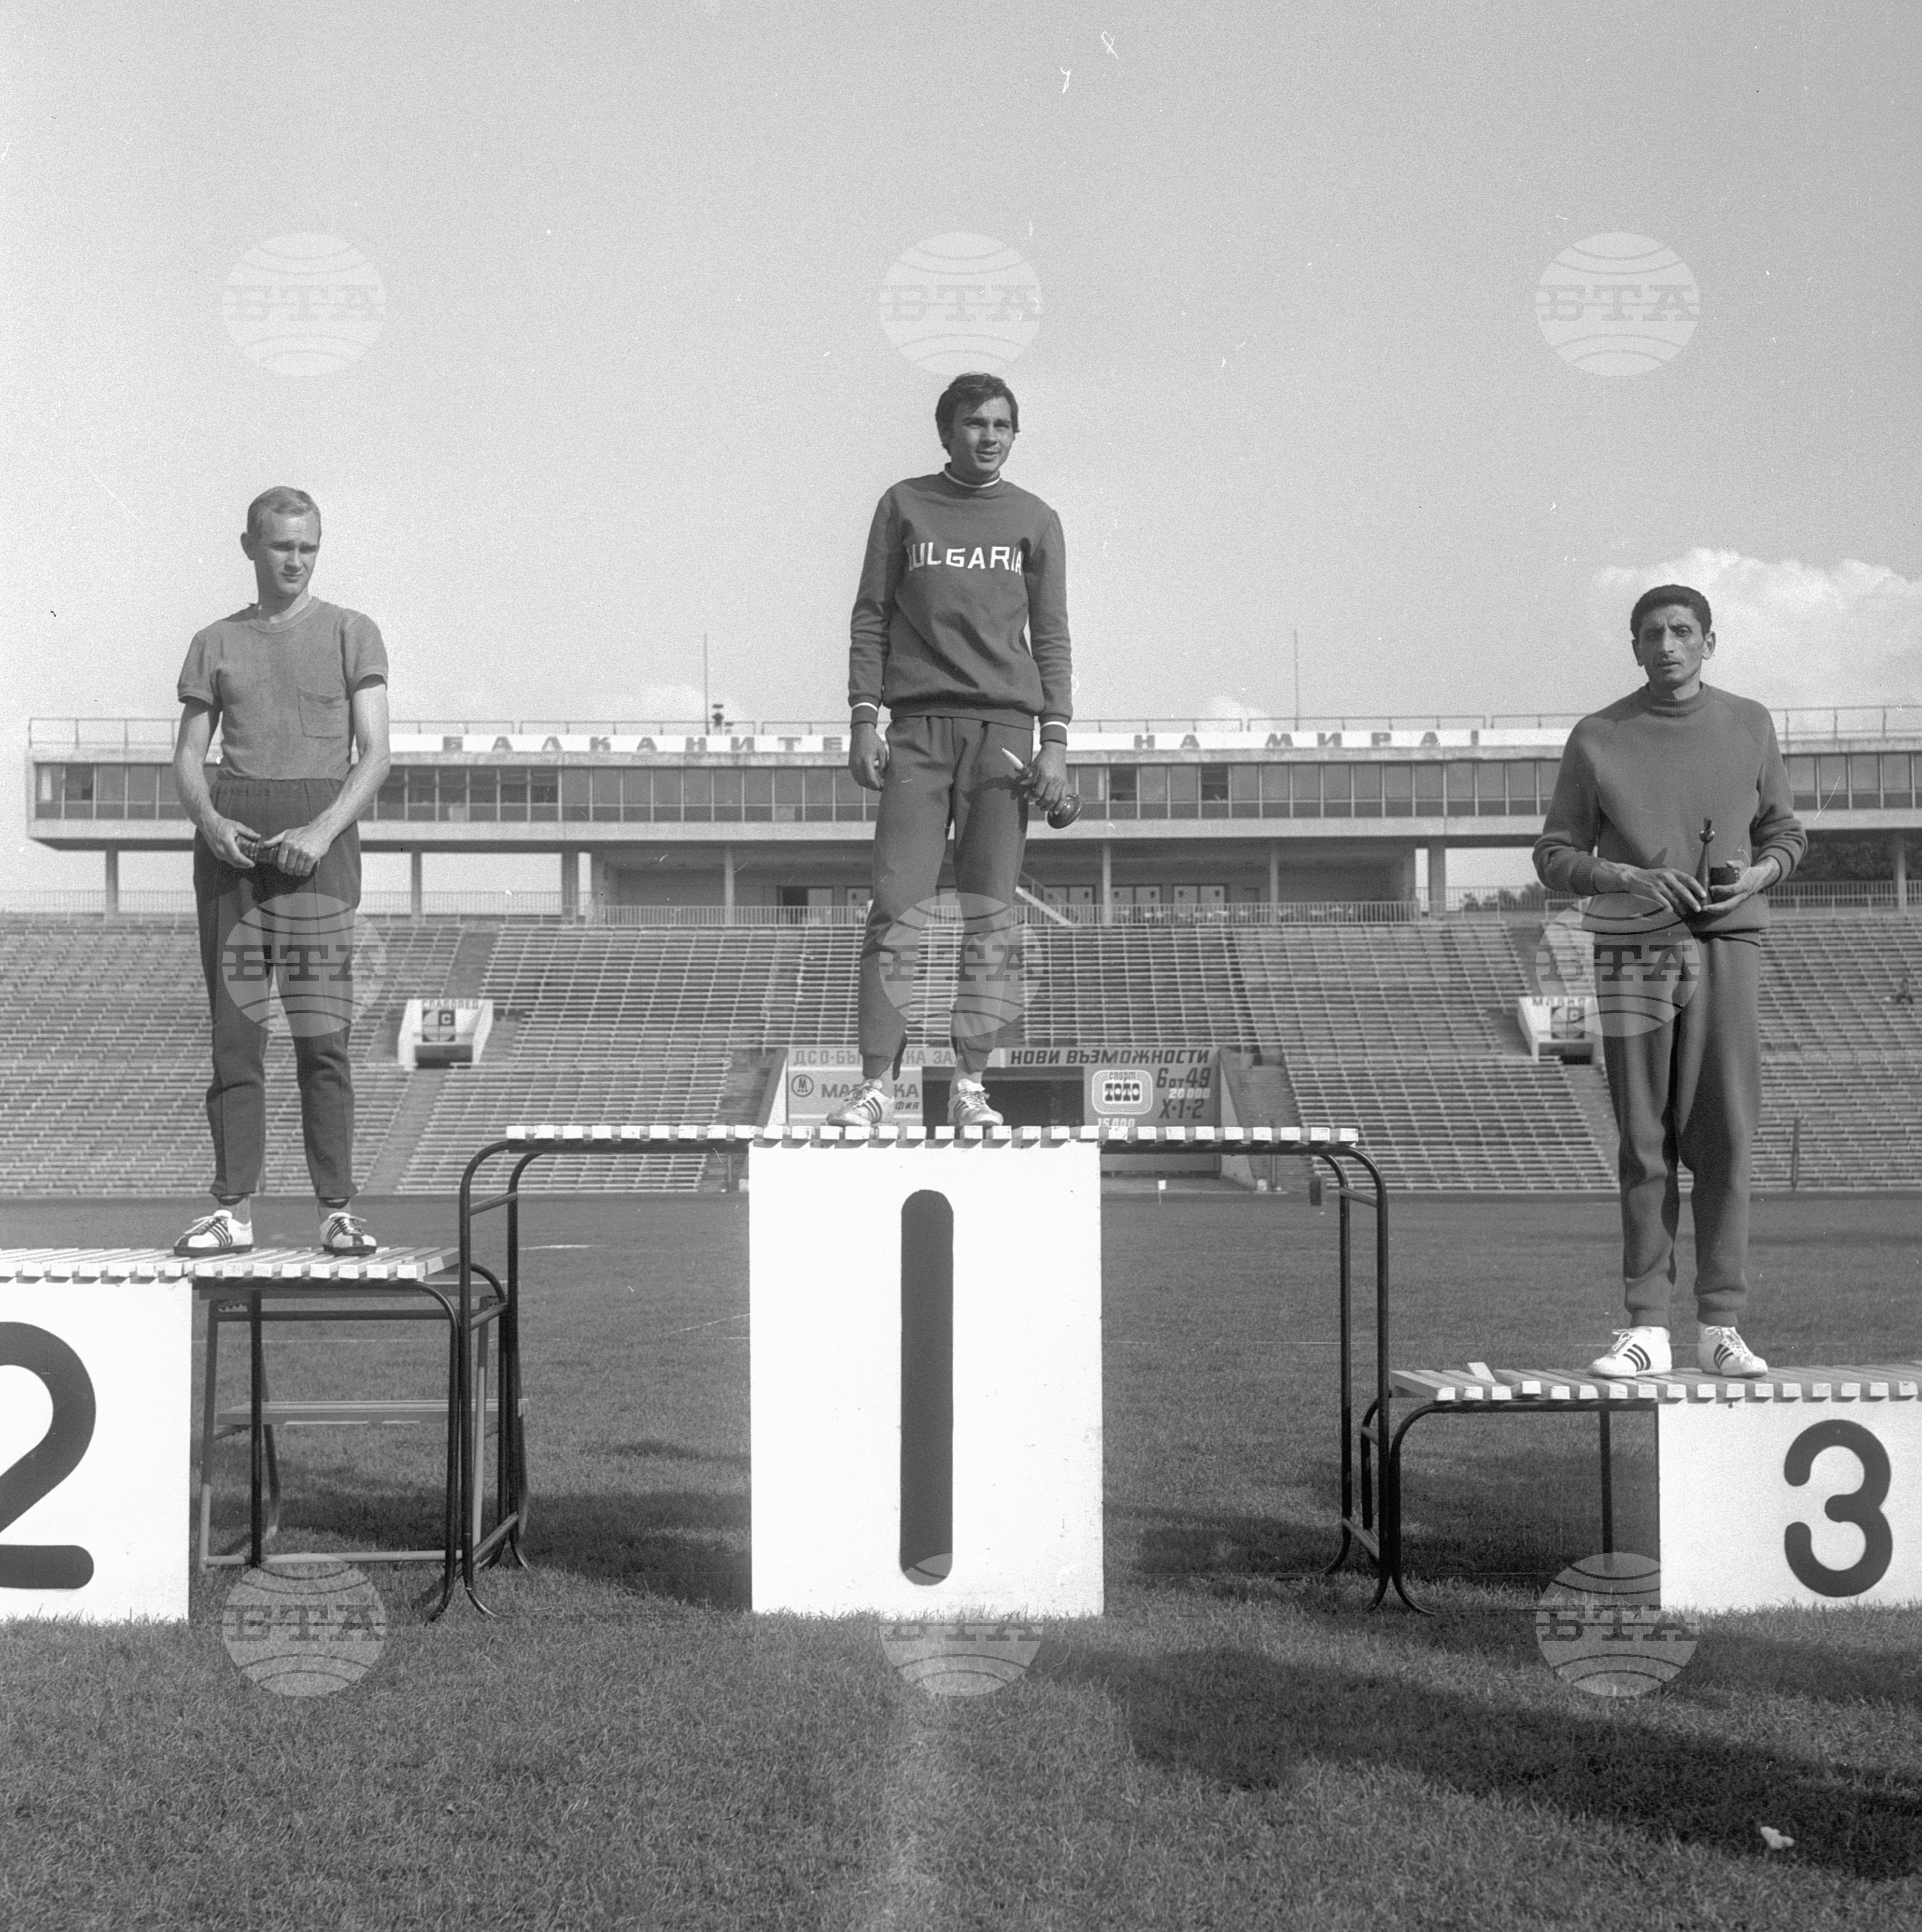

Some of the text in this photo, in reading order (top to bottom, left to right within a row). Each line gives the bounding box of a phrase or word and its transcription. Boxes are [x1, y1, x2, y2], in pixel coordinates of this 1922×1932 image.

[441, 736, 843, 752] БАЛКАНИТЕ
[1133, 734, 1201, 749] НА
[1011, 1050, 1211, 1065] НОВИ ВЪЗМОЖНОСТИ
[822, 1084, 919, 1098] МАКА
[1104, 1082, 1140, 1101] ТОТО
[0, 1321, 96, 1589] 2
[1783, 1419, 1893, 1598] 3
